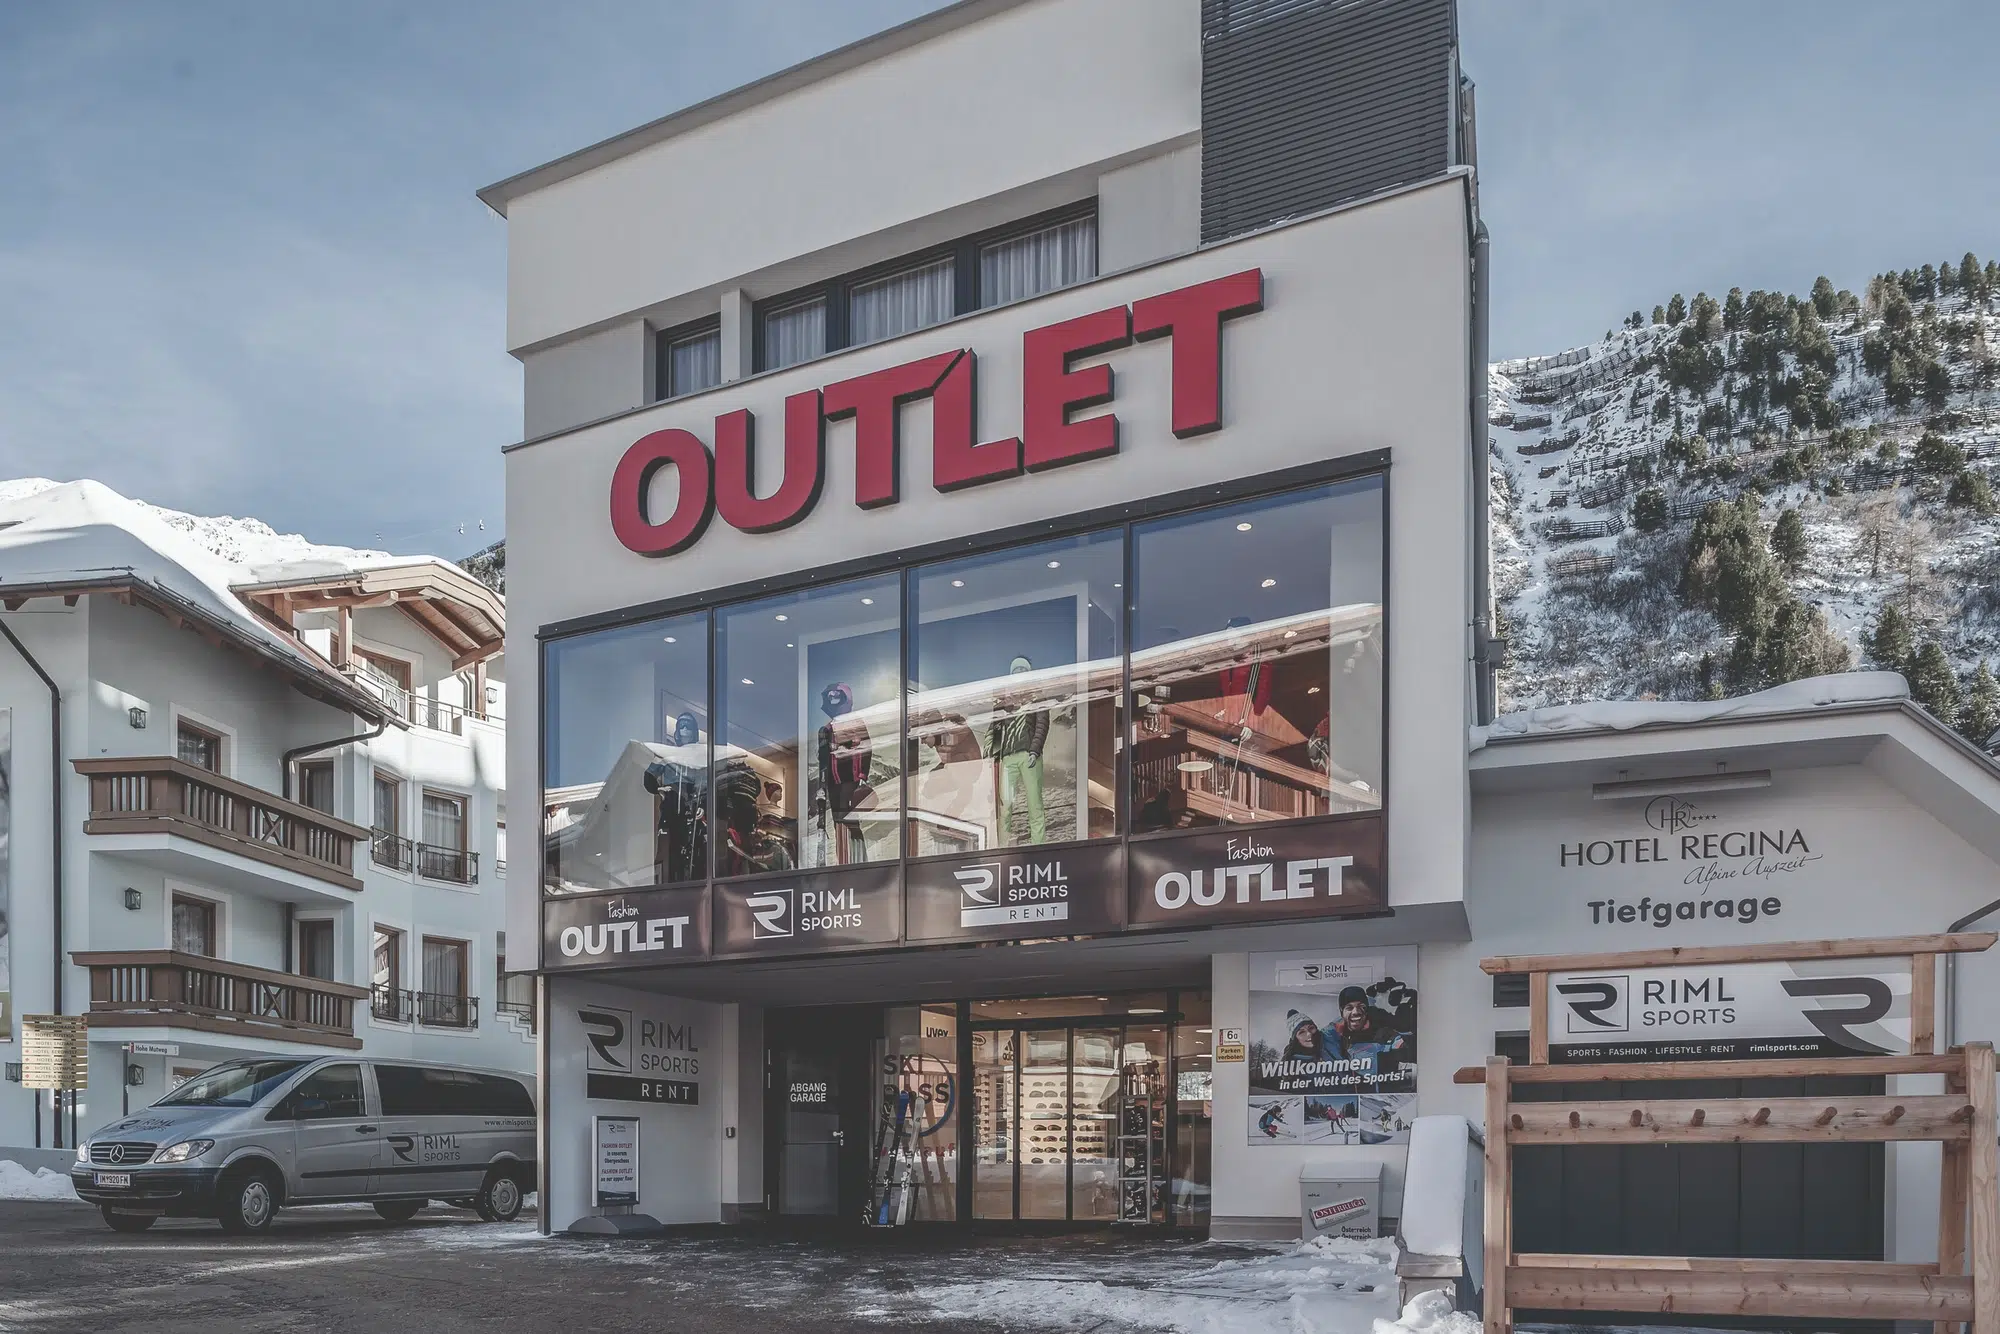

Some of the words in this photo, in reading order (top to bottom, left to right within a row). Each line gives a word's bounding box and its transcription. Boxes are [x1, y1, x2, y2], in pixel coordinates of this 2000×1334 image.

[610, 267, 1263, 558] OUTLET
[1226, 836, 1275, 861] Fashion
[1560, 837, 1668, 867] HOTEL
[1681, 828, 1810, 860] REGINA
[1008, 861, 1068, 886] RIML
[1154, 855, 1353, 910] OUTLET
[1683, 861, 1738, 896] Alpine
[1742, 854, 1824, 880] Auszeit
[801, 887, 861, 914] RIML
[1008, 884, 1068, 902] SPORTS
[607, 899, 640, 919] Fashion
[1009, 905, 1058, 920] RENT
[1587, 896, 1782, 928] Tiefgarage
[801, 913, 862, 932] SPORTS
[560, 915, 690, 957] OUTLET
[1324, 964, 1348, 973] RIML
[1643, 977, 1735, 1005] RIML
[1642, 1008, 1736, 1026] SPORTS
[641, 1020, 698, 1053] RIML
[1567, 1049, 1600, 1058] SPORTS
[1608, 1048, 1647, 1056] FASHION
[1655, 1046, 1702, 1055] LIFESTYLE
[1710, 1045, 1735, 1053] RENT
[1749, 1043, 1819, 1053] rimlsports.com
[641, 1053, 699, 1075] SPORTS
[883, 1053, 923, 1075] SKI
[1261, 1056, 1372, 1078] Willkommen
[790, 1082, 827, 1092] ABGANG
[1279, 1079, 1290, 1090] in
[1292, 1078, 1309, 1089] der
[1314, 1075, 1339, 1087] Welt
[1341, 1075, 1361, 1085] des
[1363, 1070, 1406, 1084] Sports!
[641, 1083, 690, 1100] RENT
[790, 1092, 827, 1103] GARAGE
[883, 1082, 950, 1104] PSS
[423, 1135, 460, 1150] RIML
[424, 1151, 461, 1162] SPORTS
